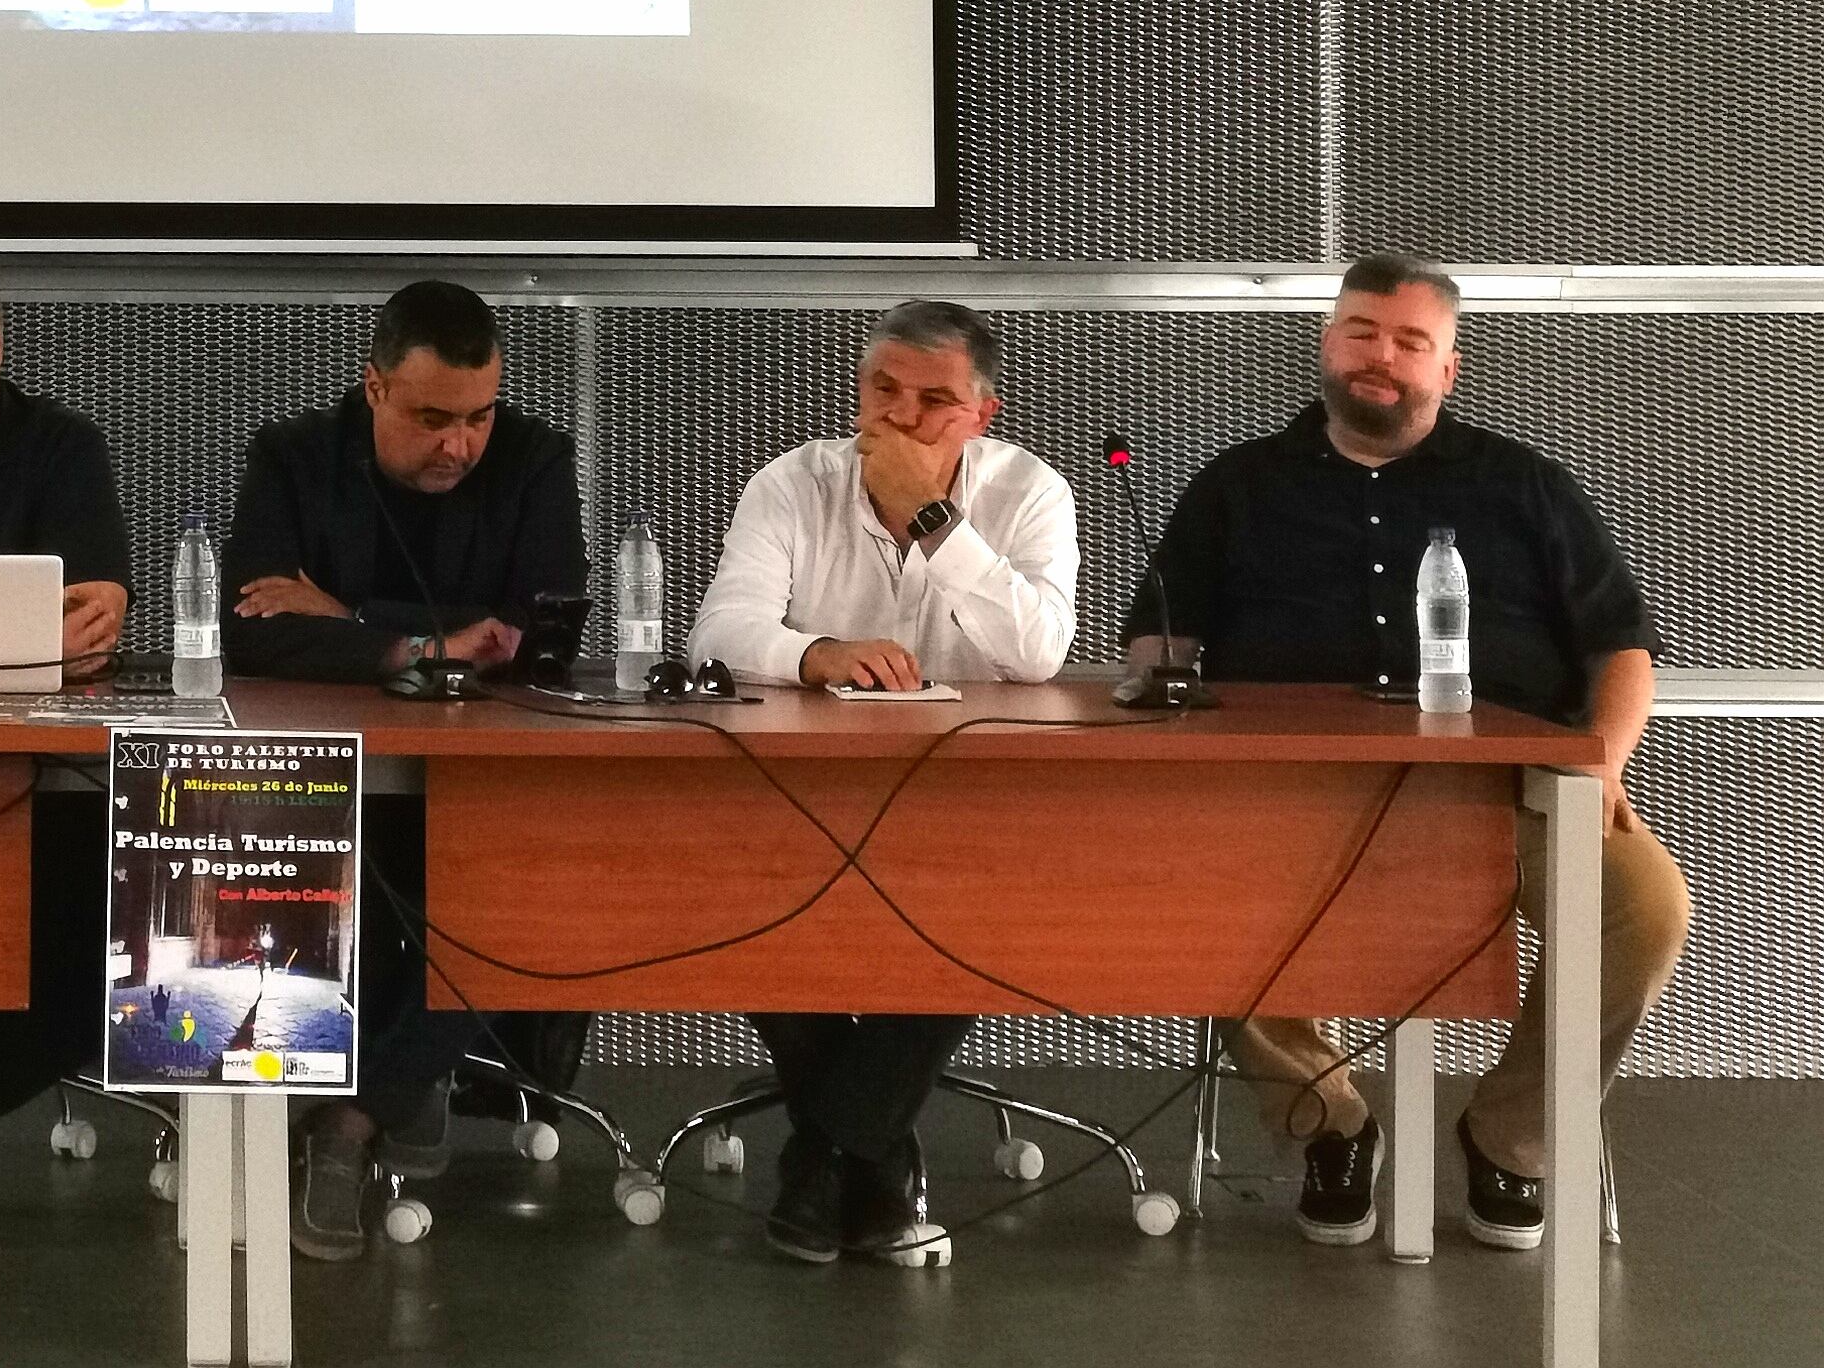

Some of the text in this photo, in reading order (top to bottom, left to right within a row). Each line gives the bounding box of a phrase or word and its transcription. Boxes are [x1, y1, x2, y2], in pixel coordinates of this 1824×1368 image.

[117, 742, 160, 769] XI
[167, 743, 354, 758] FORO PALENTINO
[167, 757, 301, 771] DE TURISMO
[308, 781, 349, 795] Junio
[115, 830, 353, 853] Palencia Turismo
[169, 858, 298, 880] y Deporte
[246, 888, 301, 902] Alberto
